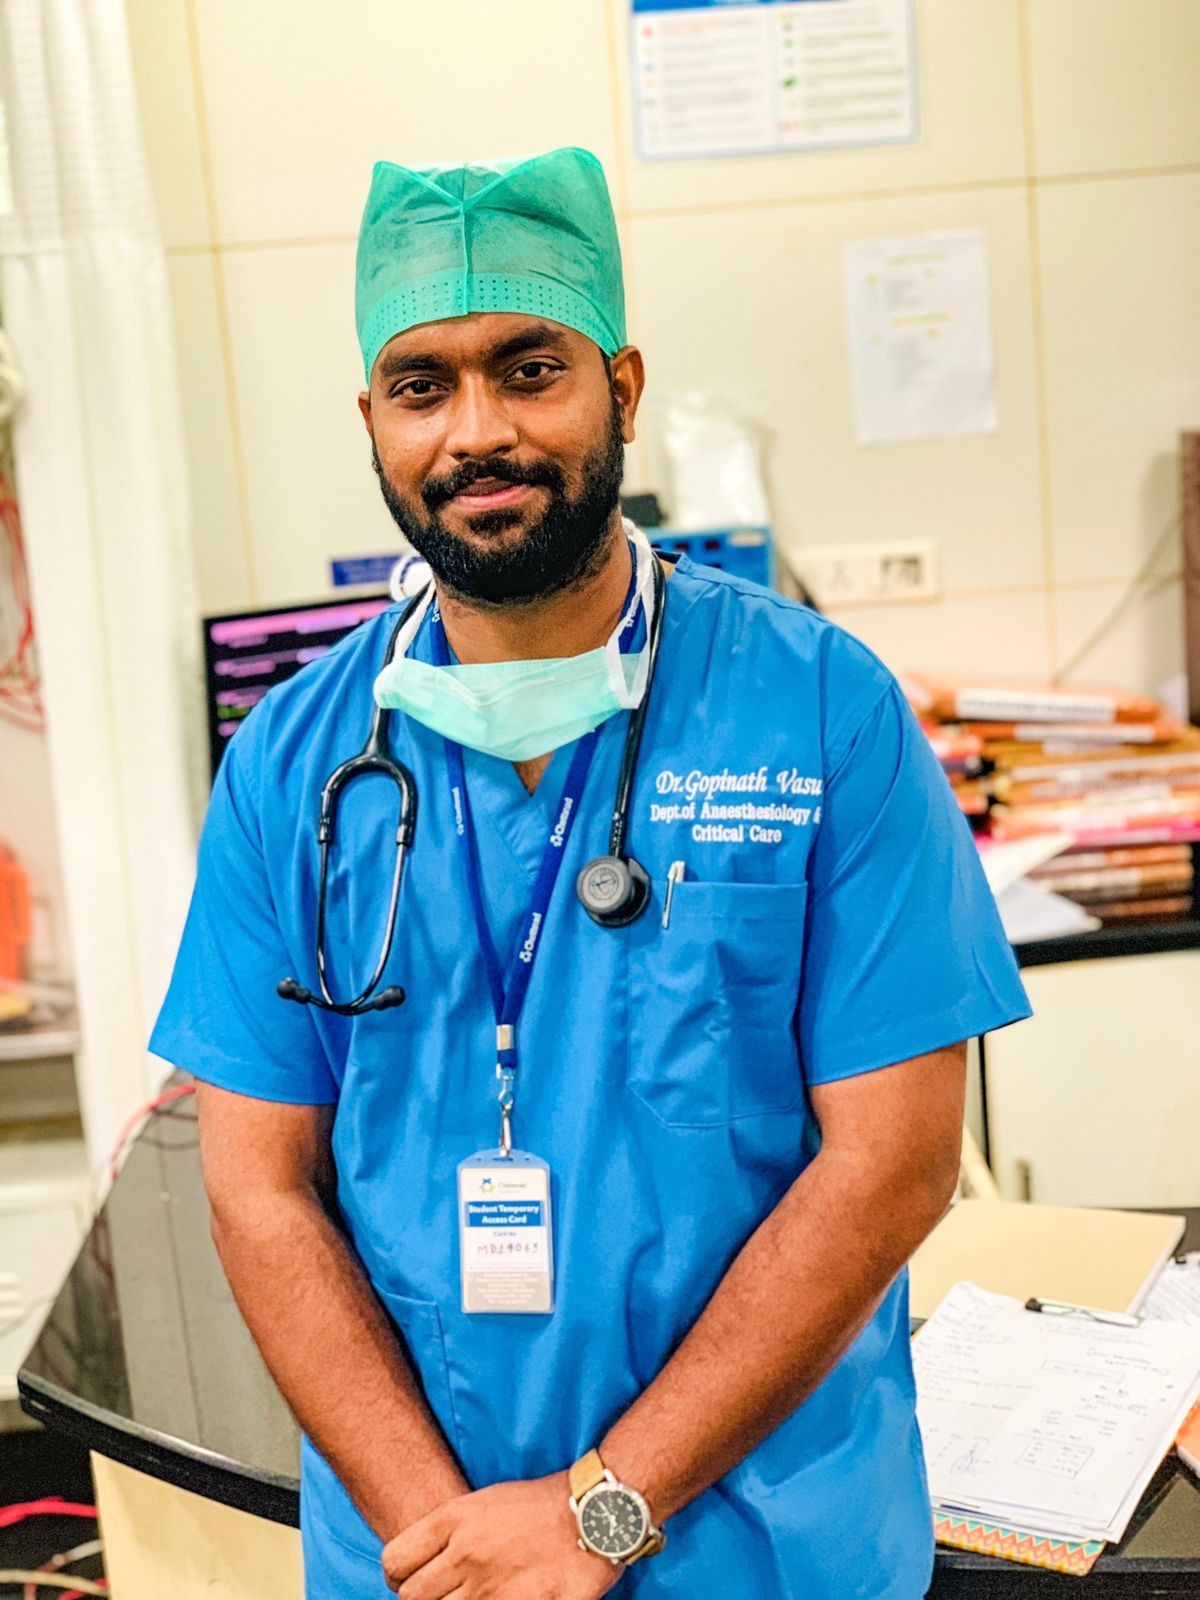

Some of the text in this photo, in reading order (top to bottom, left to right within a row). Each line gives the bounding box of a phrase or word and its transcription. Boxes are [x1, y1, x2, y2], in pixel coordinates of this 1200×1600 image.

[656, 767, 822, 800] Dr.Gopinath Vasu
[650, 803, 695, 823] Dept.of
[701, 803, 810, 825] Anaesthesiology
[692, 824, 782, 843] Critical Care
[468, 1204, 539, 1214] Student Temporary
[481, 1215, 528, 1224] Access Card
